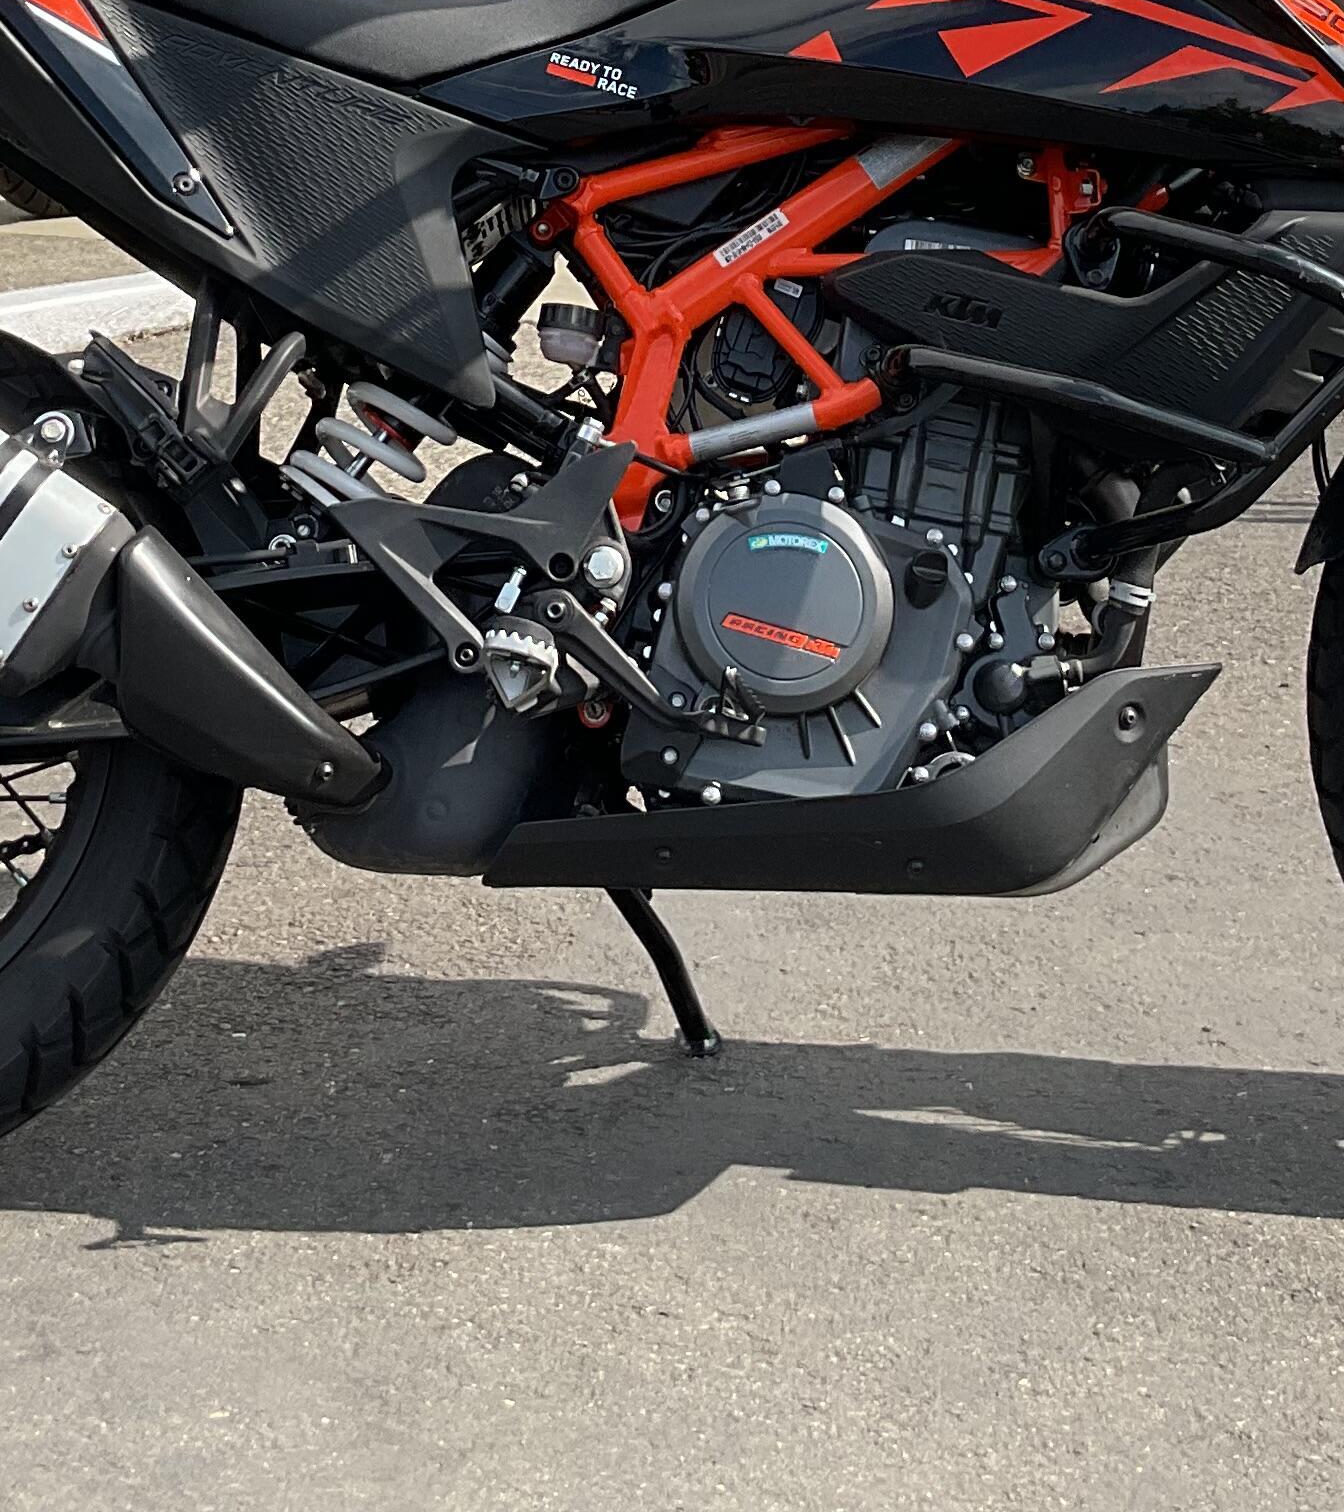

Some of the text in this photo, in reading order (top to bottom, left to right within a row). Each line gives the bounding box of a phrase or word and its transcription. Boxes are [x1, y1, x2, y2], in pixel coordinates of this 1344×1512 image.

[549, 51, 623, 81] READY TO
[596, 78, 638, 100] RACE
[923, 290, 1003, 330] KTM
[767, 534, 825, 553] MOTOREX
